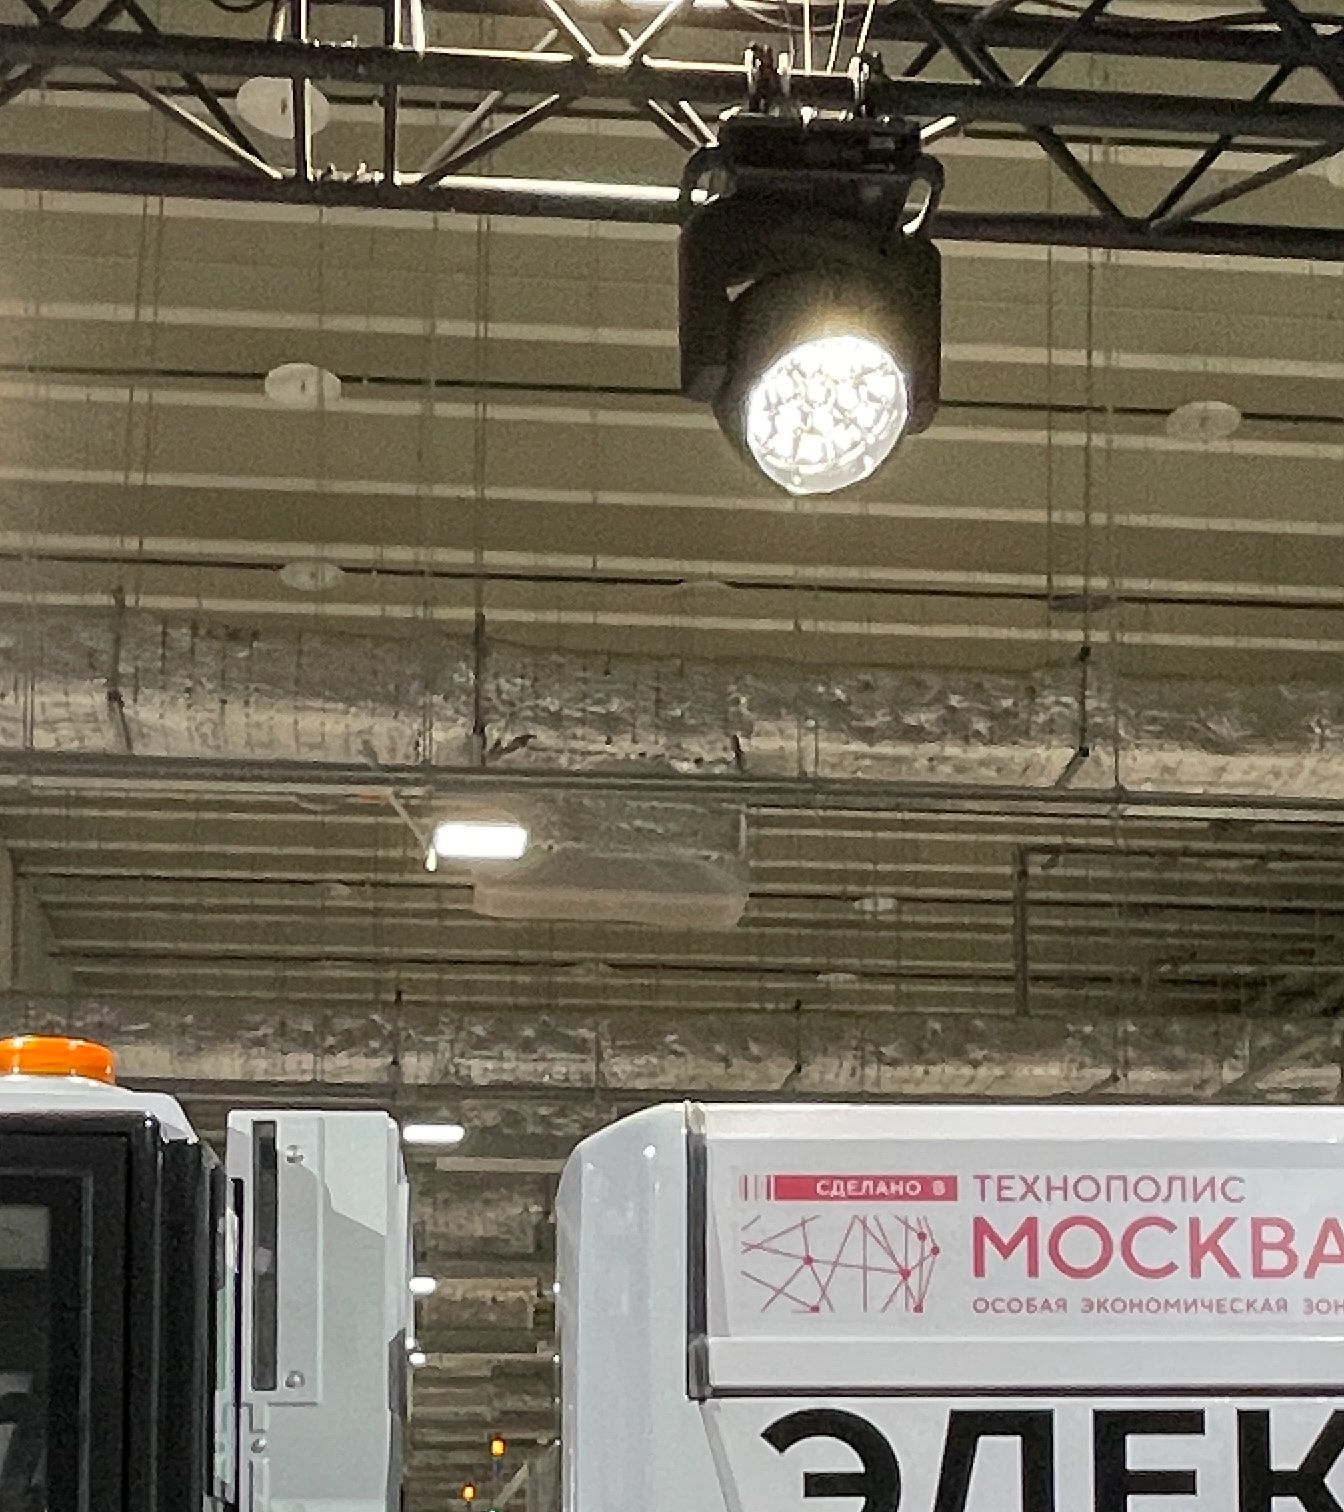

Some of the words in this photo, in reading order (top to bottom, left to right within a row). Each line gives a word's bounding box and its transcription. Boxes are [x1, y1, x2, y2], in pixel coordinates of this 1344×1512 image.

[815, 1180, 922, 1198] СДЕЛАНО
[973, 1174, 1246, 1204] ТЕХНОПОЛИС
[972, 1297, 1068, 1315] ОСОБАЯ
[1081, 1297, 1288, 1315] ЭКОНОМИЧЕСКАЯ
